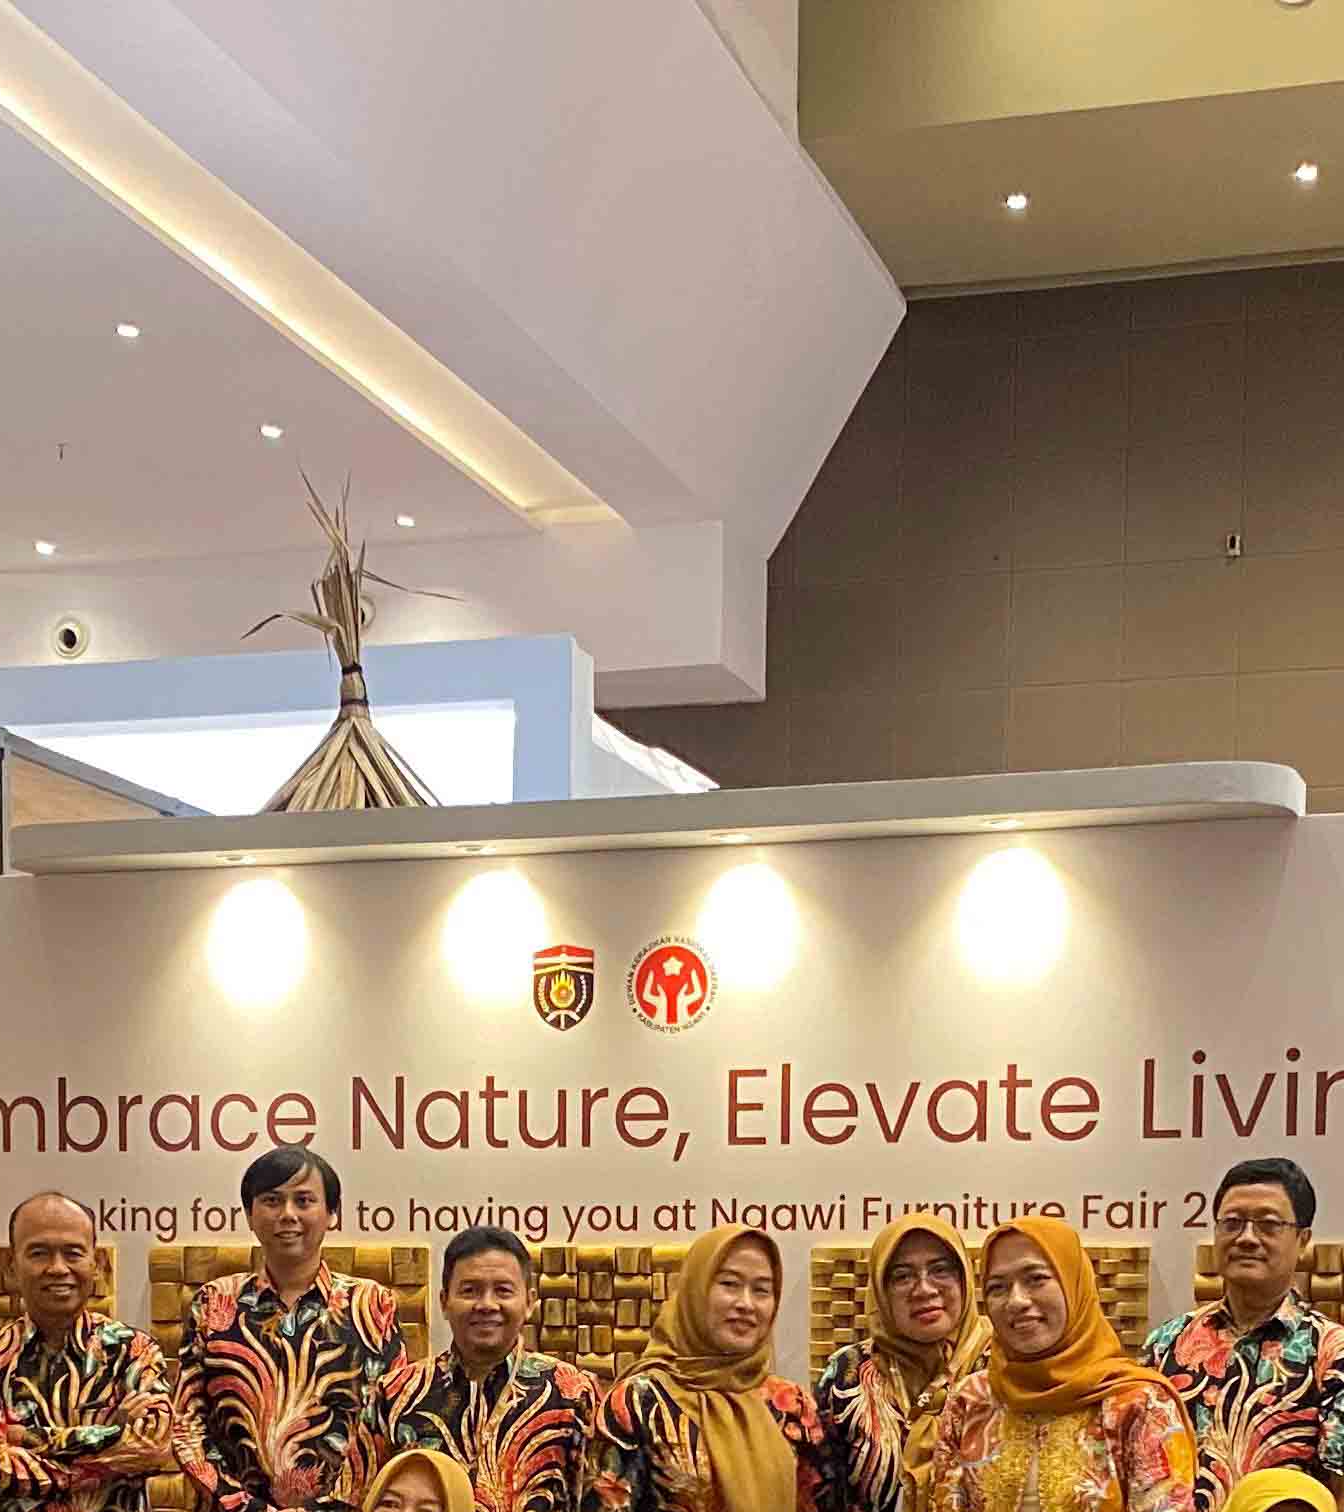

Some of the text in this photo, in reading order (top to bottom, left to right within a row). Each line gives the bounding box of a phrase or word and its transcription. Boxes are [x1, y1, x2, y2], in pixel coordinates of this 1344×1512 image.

[352, 1075, 690, 1162] Nature,
[727, 1063, 1100, 1146] Elevate
[99, 1197, 177, 1242] king
[356, 1199, 395, 1232] to
[409, 1197, 549, 1243] having
[563, 1203, 639, 1243] you
[653, 1199, 697, 1232] at
[1082, 1191, 1167, 1230] Fair
